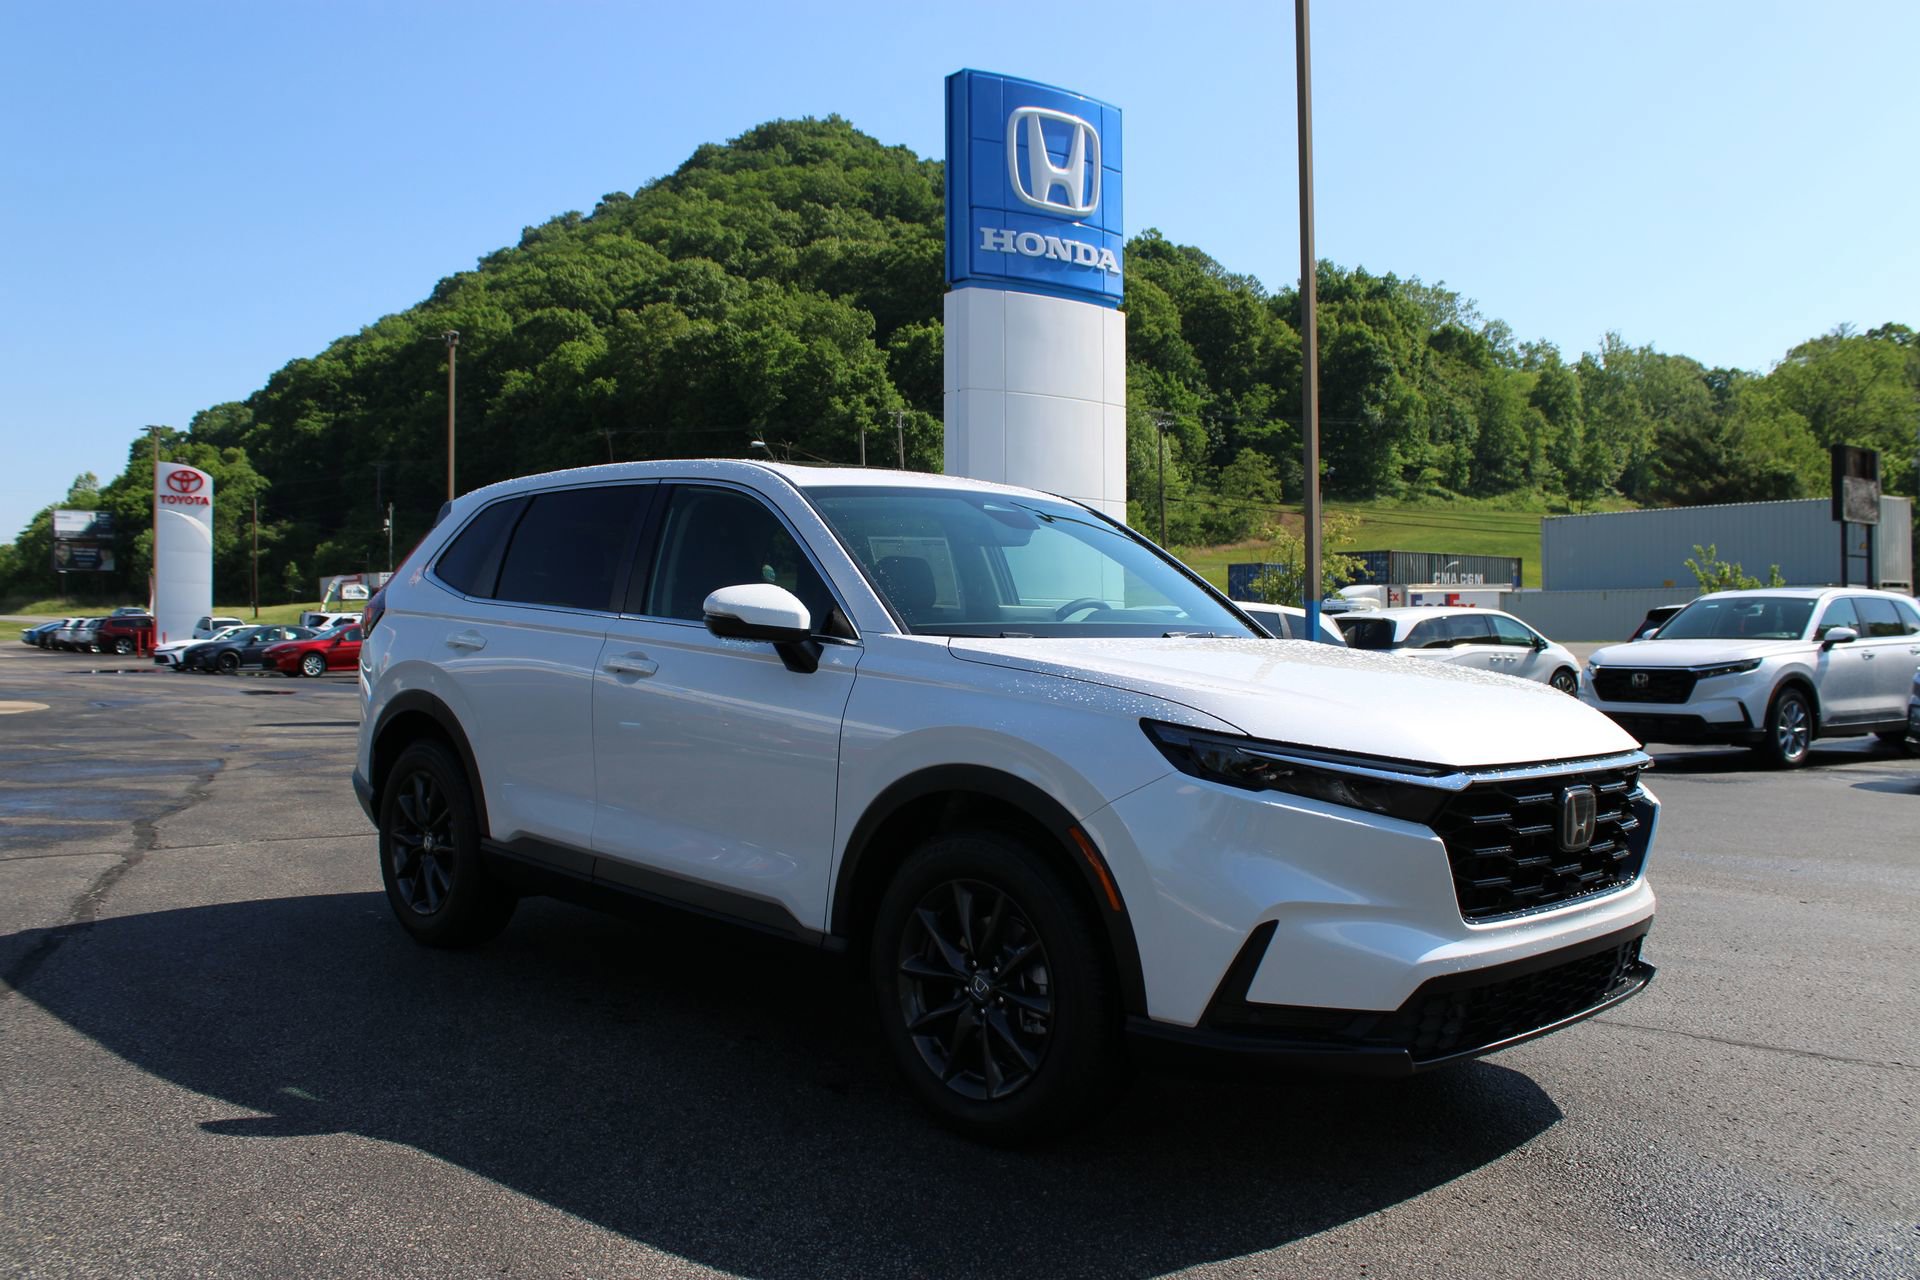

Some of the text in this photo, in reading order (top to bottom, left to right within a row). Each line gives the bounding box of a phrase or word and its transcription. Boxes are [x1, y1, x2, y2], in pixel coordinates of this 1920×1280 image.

[980, 227, 1120, 274] HONDA
[160, 494, 209, 505] TOYOTA
[1434, 572, 1484, 585] CMA CGM
[1410, 594, 1476, 607] FdE
